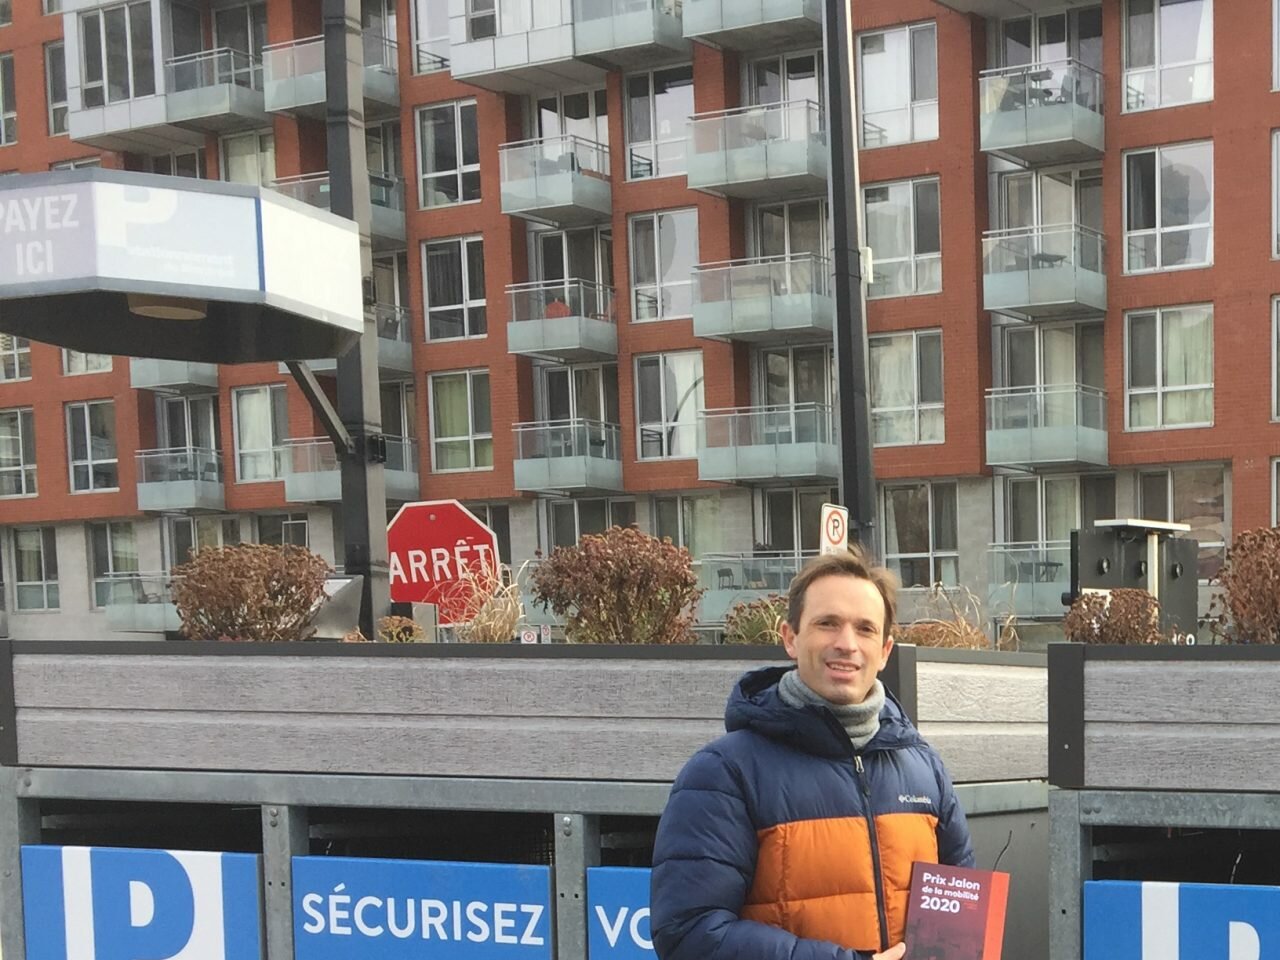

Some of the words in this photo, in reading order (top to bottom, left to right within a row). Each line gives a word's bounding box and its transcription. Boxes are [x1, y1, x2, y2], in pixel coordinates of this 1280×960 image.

[0, 193, 79, 233] AYEZ
[16, 240, 54, 275] ICI
[389, 539, 489, 585] ARRÊT
[921, 885, 934, 894] de
[934, 886, 943, 895] la
[944, 889, 979, 901] mobilité
[923, 872, 947, 886] Prix
[948, 876, 981, 891] Jalon
[302, 883, 545, 946] SÉCURISEZ
[594, 905, 655, 950] VO
[920, 895, 961, 913] 2020
